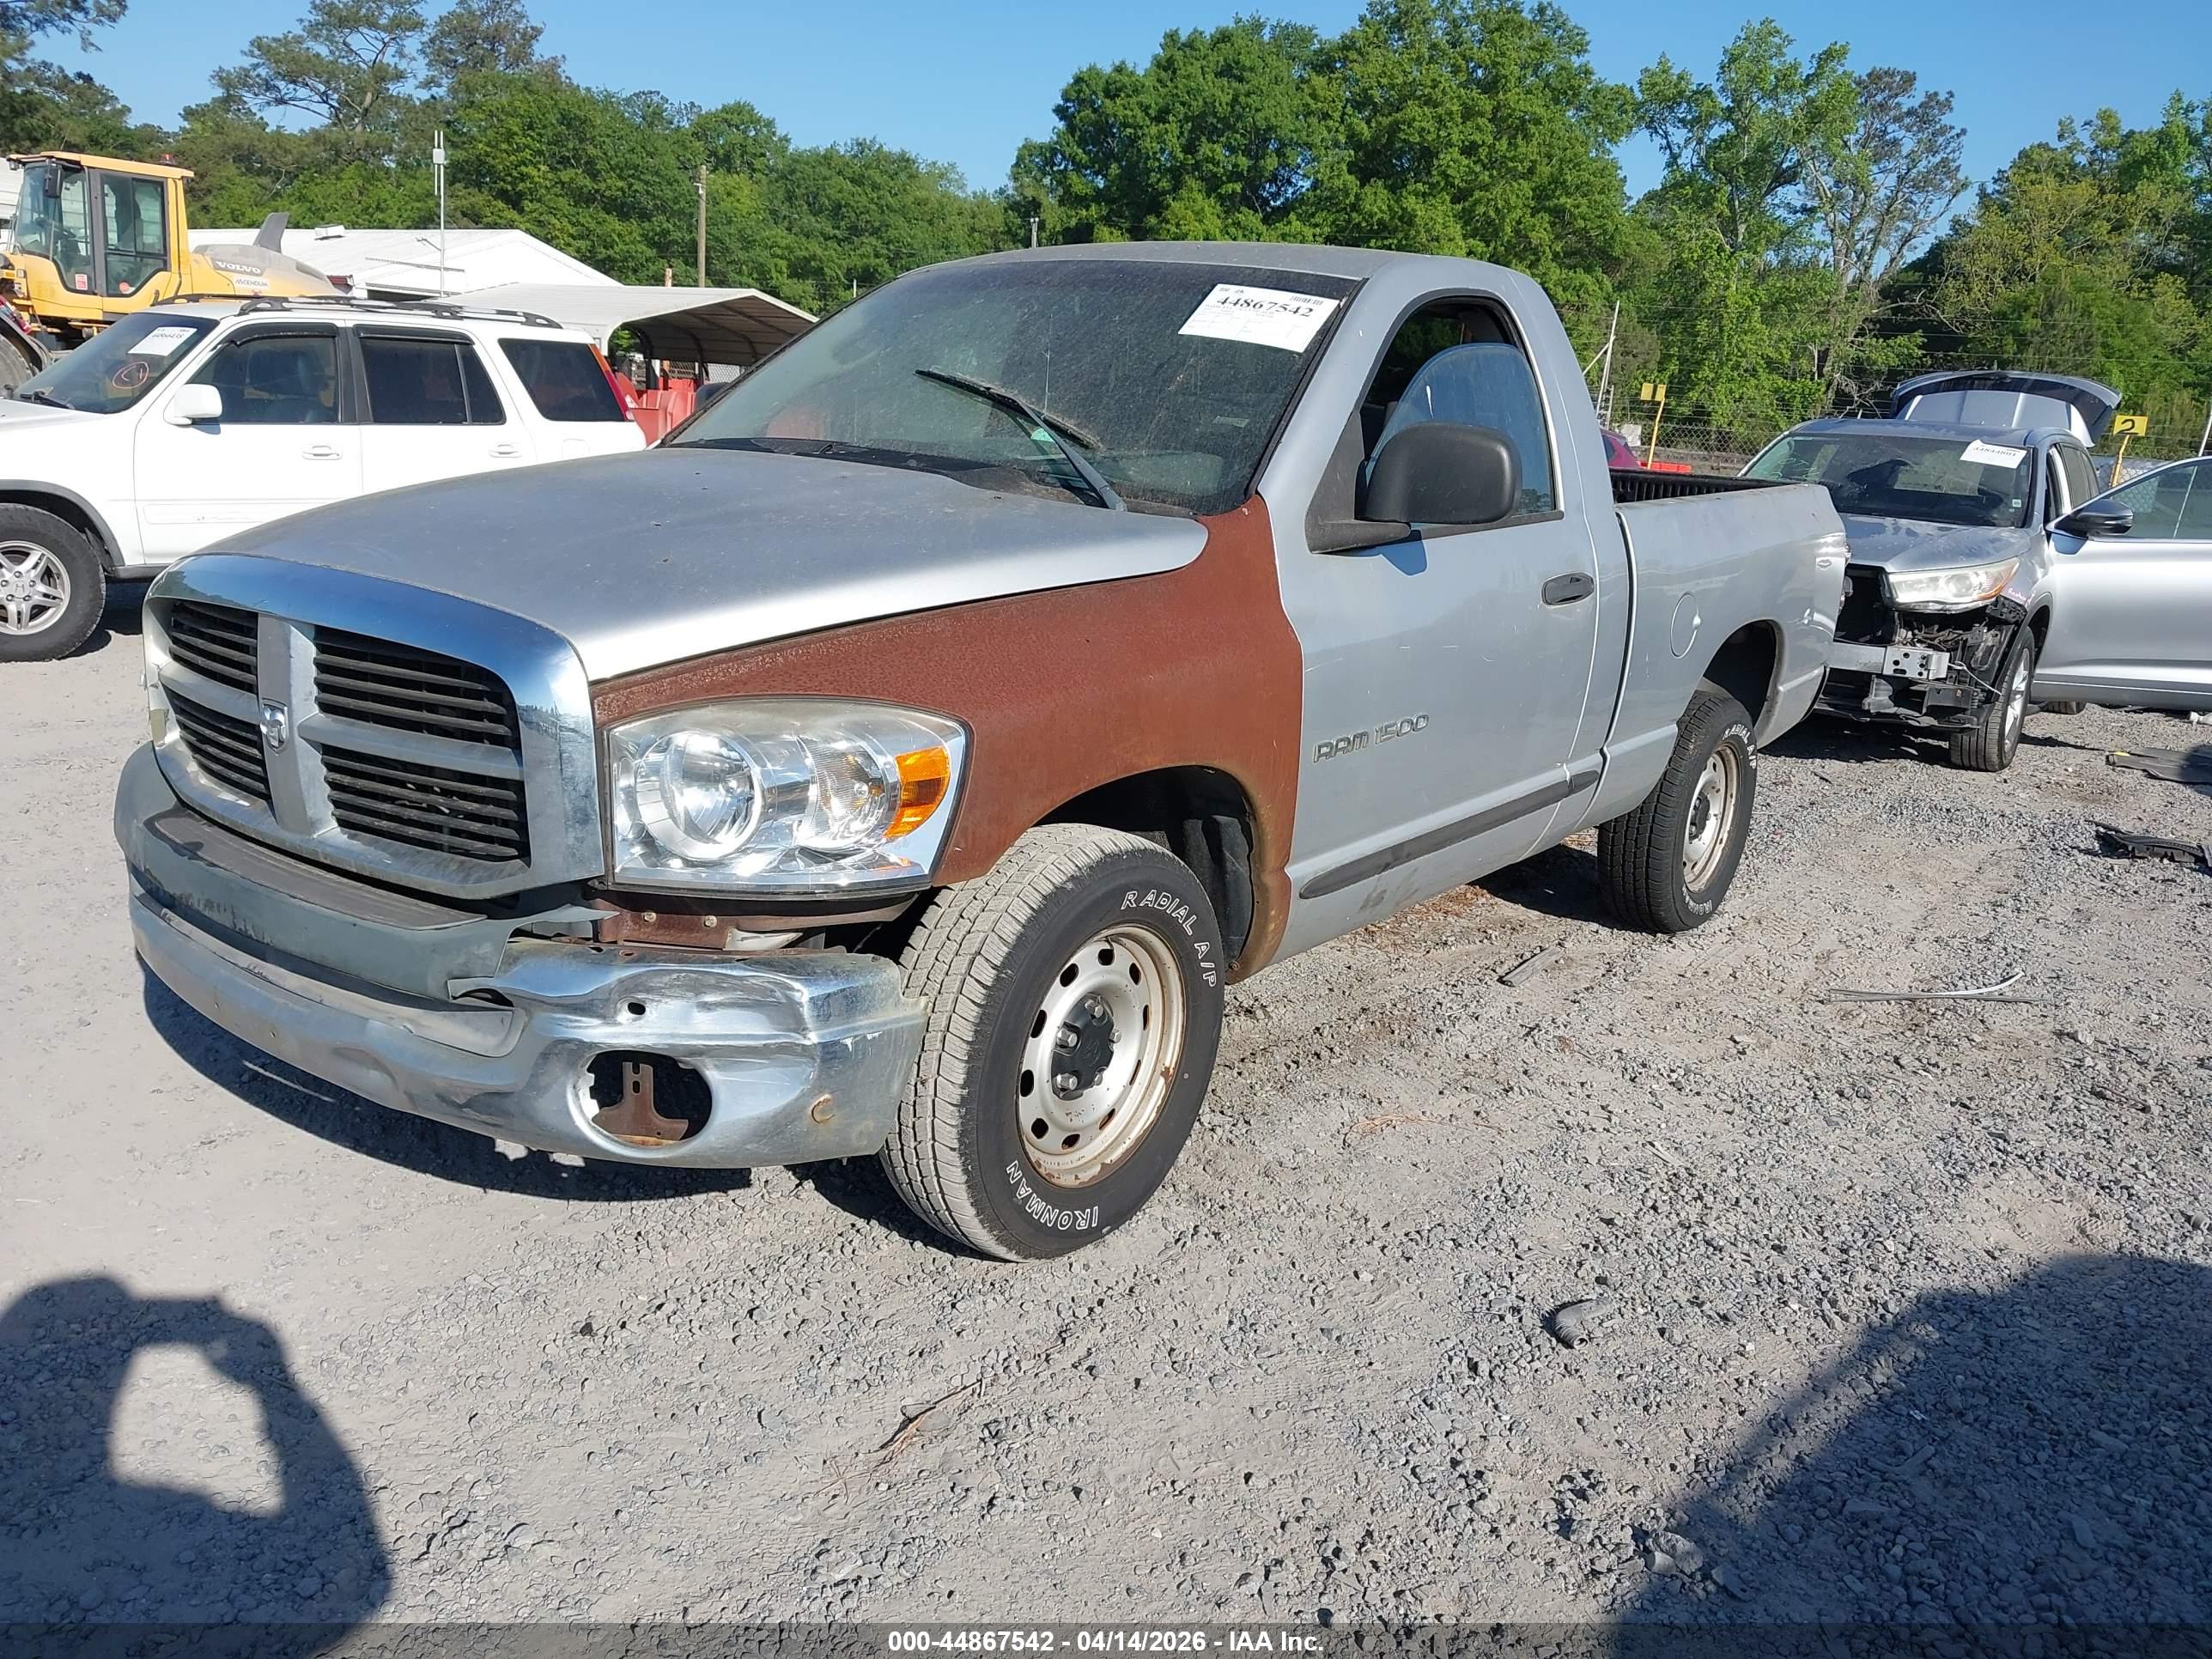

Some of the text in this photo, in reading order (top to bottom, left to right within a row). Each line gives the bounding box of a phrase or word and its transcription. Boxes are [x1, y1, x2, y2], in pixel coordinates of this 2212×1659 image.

[215, 261, 261, 274] VOLVO
[235, 278, 269, 288] ASCENDUM
[1217, 296, 1315, 318] 44867542
[2116, 418, 2139, 434] 2
[1313, 713, 1430, 763] RAM 1500
[1121, 890, 1217, 988] RADIAL A/P
[1006, 1159, 1099, 1231] IRONMAN
